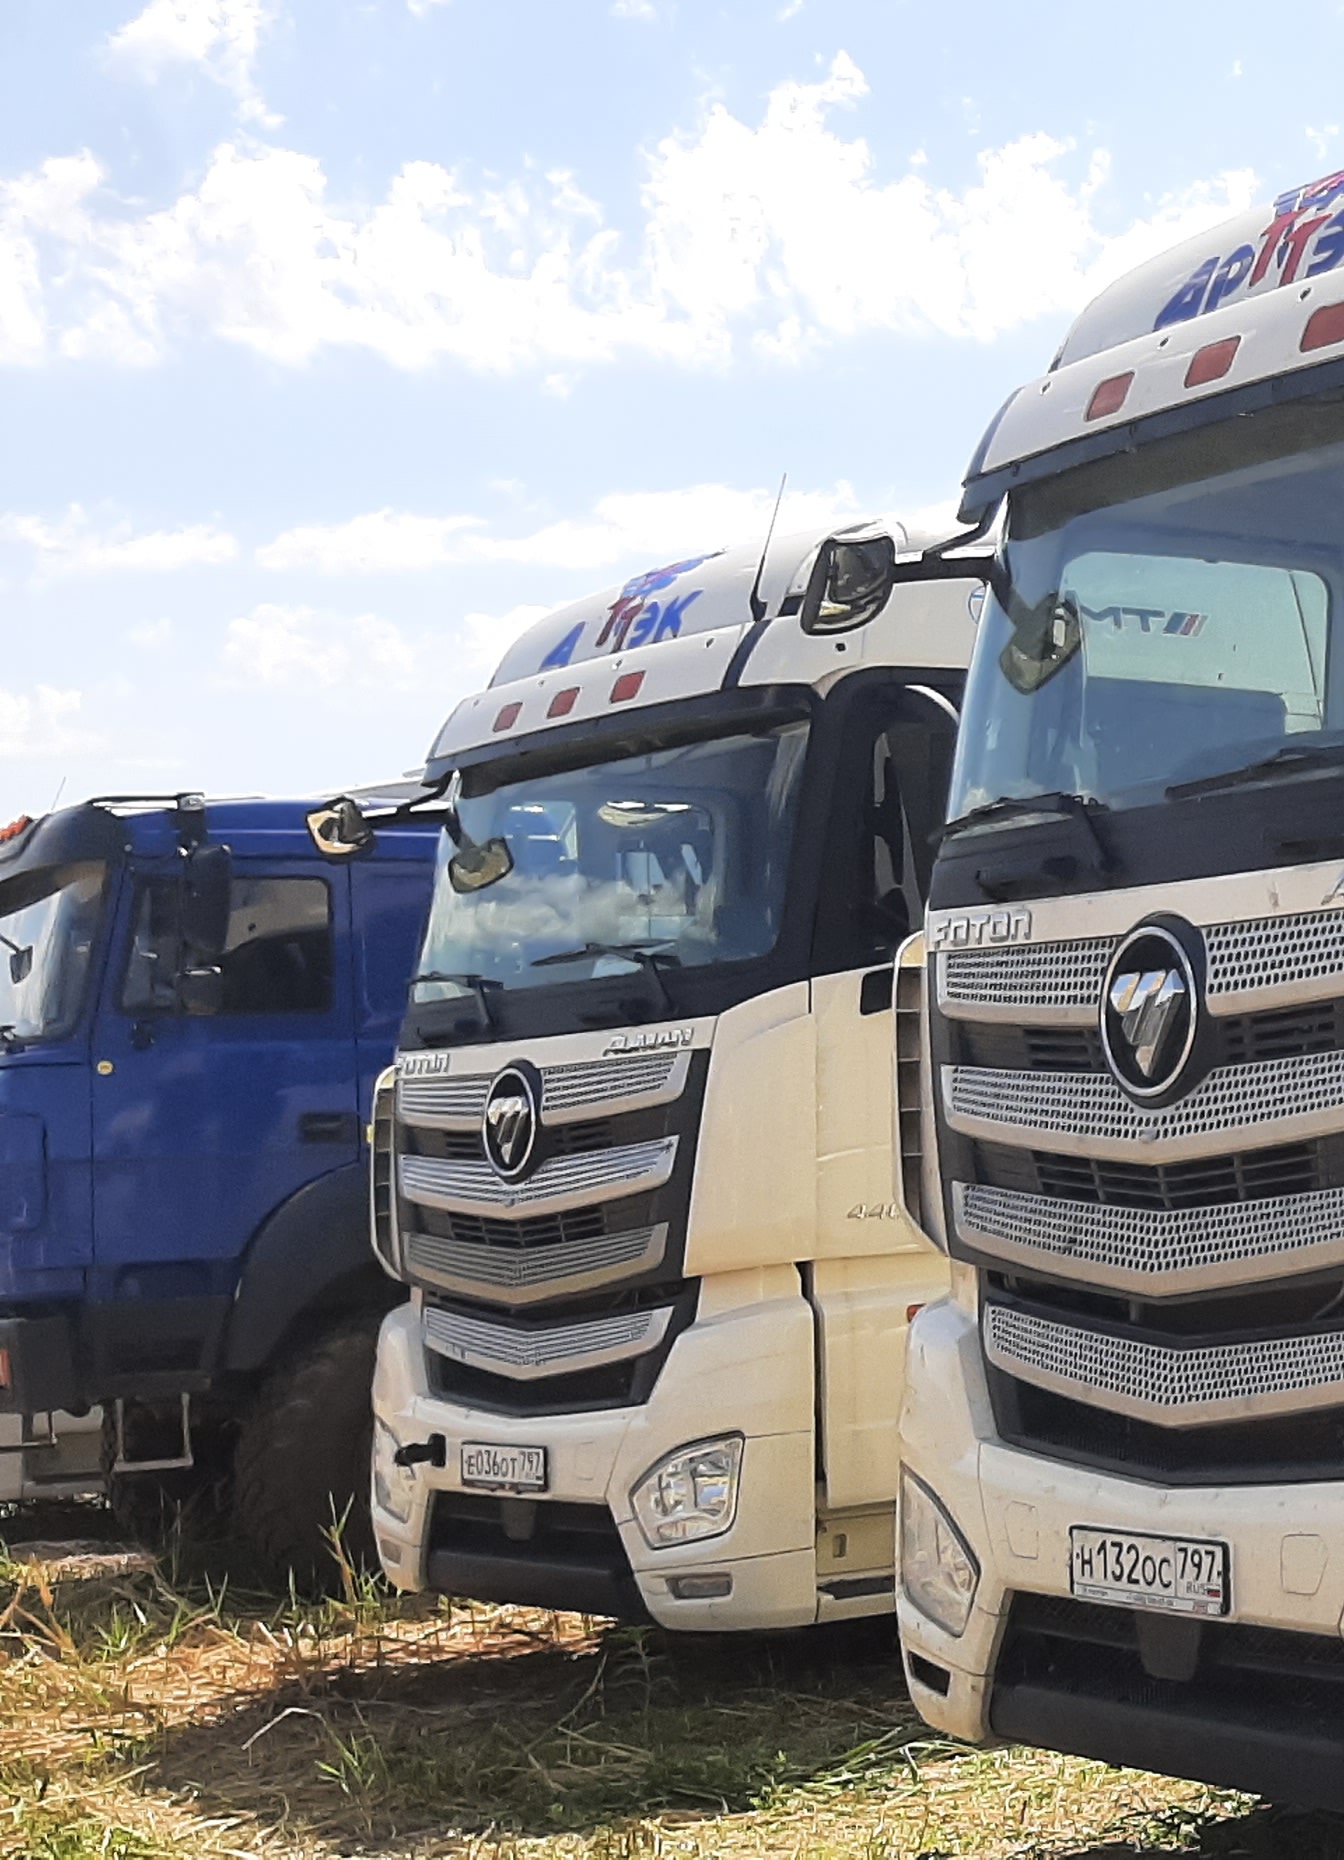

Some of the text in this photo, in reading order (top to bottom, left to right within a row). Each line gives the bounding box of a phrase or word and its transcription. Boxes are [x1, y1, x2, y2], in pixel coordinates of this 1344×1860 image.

[933, 909, 1032, 948] FOTON
[1080, 1539, 1216, 1589] Н132ОС 797
